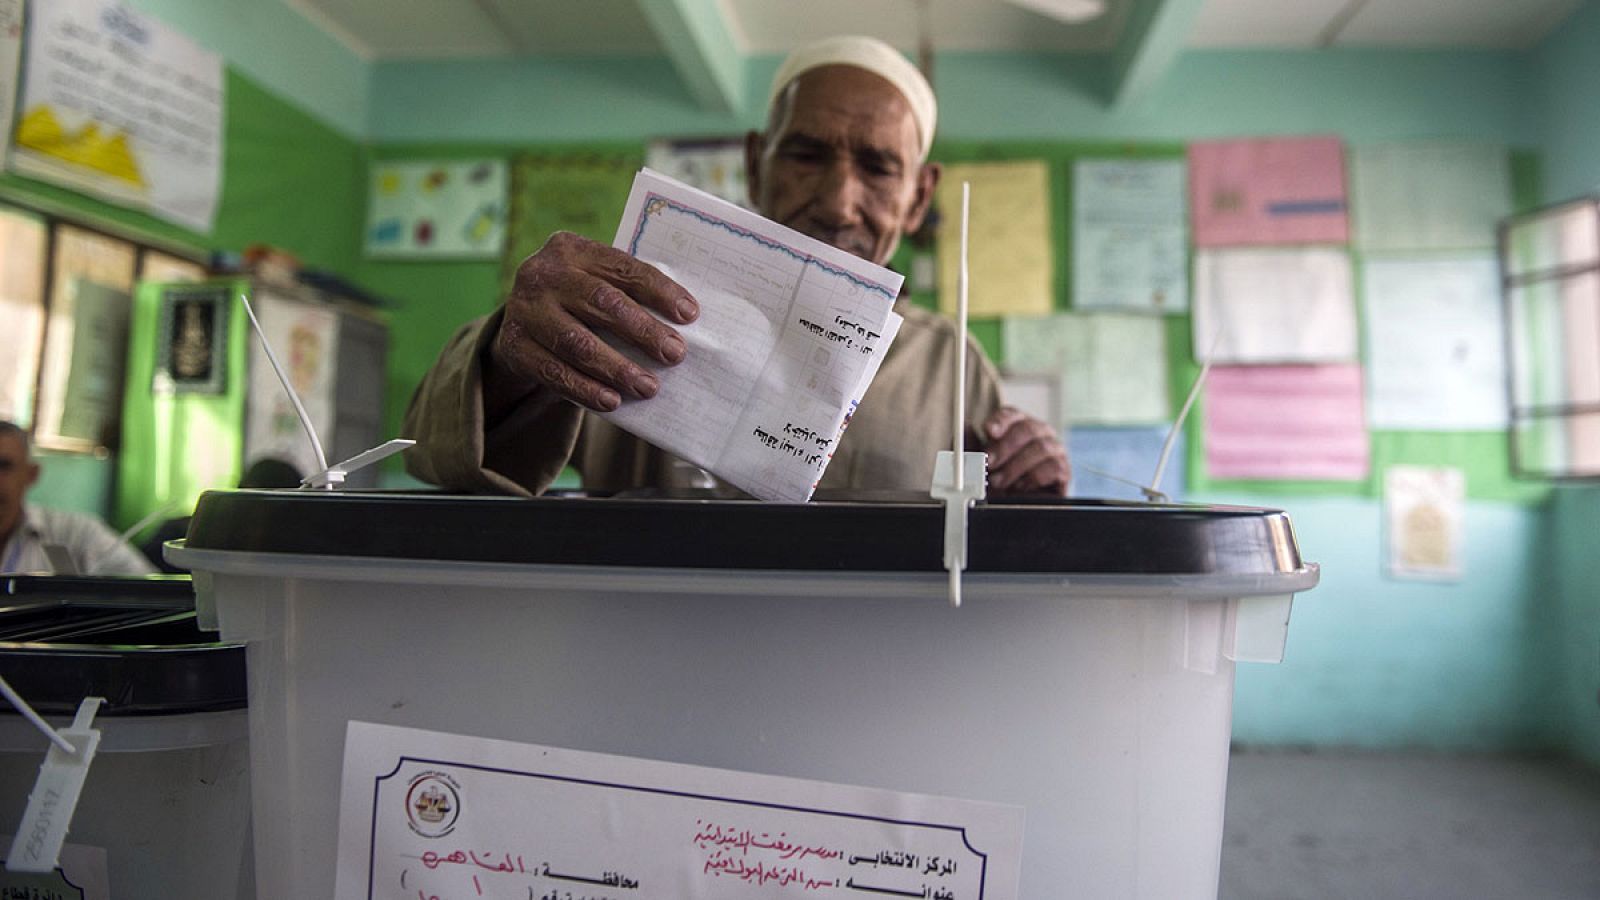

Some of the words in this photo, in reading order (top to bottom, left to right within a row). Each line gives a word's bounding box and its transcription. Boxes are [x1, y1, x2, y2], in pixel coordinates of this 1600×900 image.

[799, 318, 825, 337] محافظة
[825, 331, 853, 349] القاهرة
[866, 331, 881, 341] قس
[753, 426, 778, 449] بطاقة
[779, 437, 804, 457] إبداء
[804, 454, 823, 472] الرأ
[783, 422, 817, 442] لاختيار
[815, 438, 833, 450] متر
[921, 858, 957, 877] المركز
